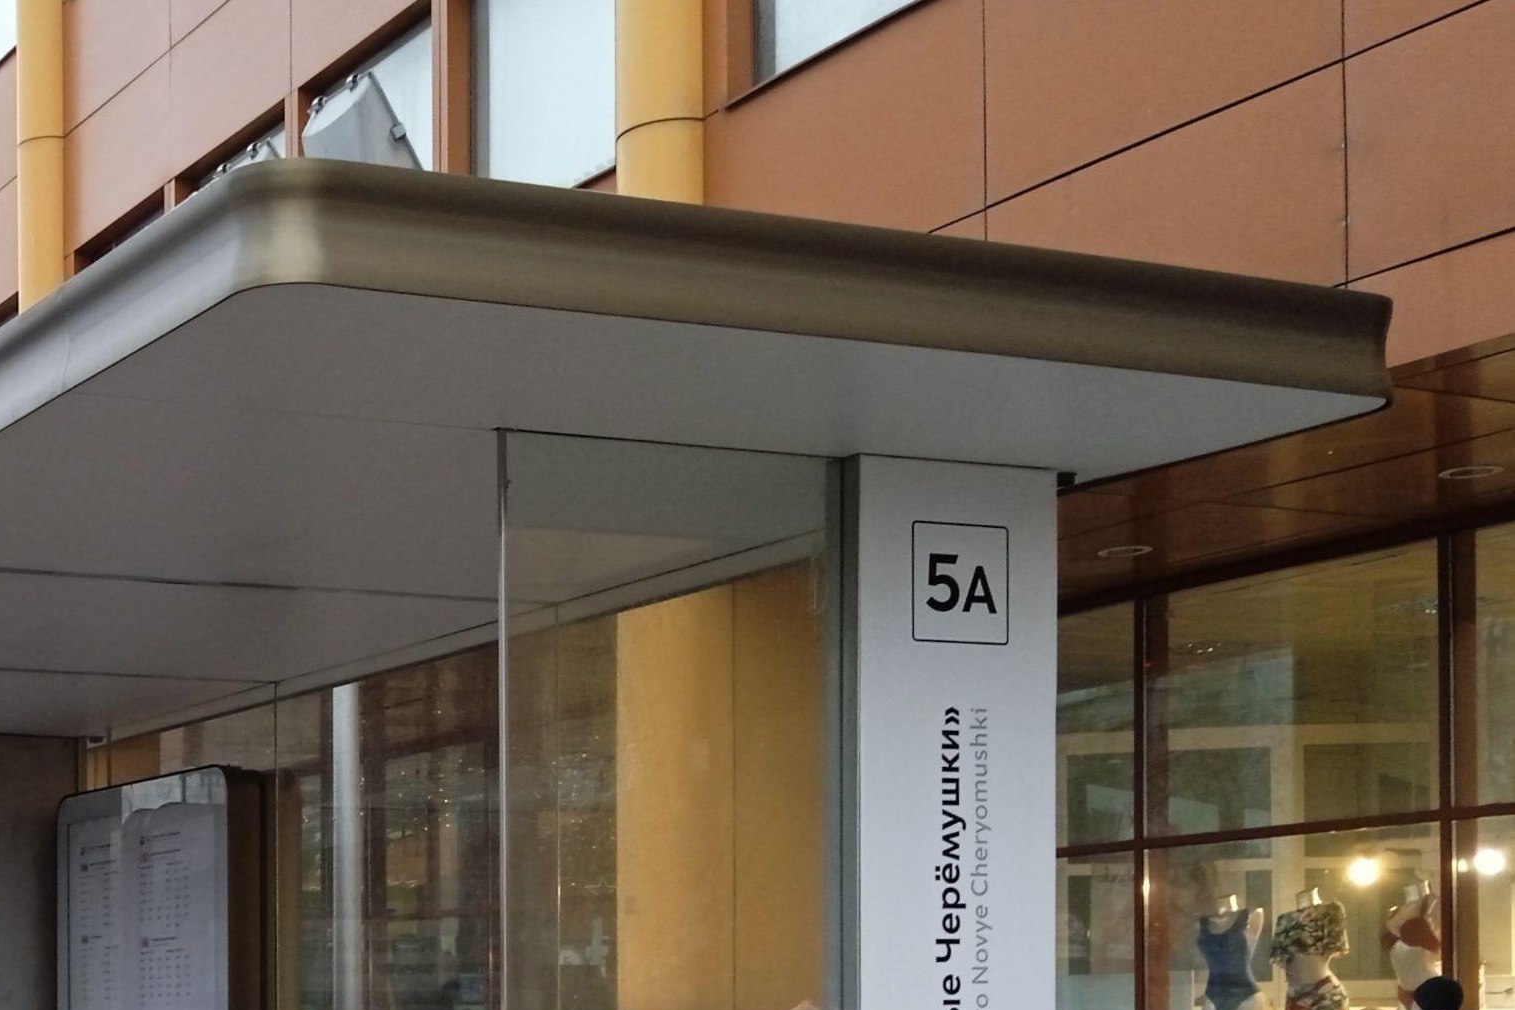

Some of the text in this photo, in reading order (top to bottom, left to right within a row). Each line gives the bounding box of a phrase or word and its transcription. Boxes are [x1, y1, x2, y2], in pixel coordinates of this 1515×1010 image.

[935, 706, 967, 963] Черёмушки»
[970, 708, 992, 896] Cheryomushki
[972, 905, 993, 985] Novye
